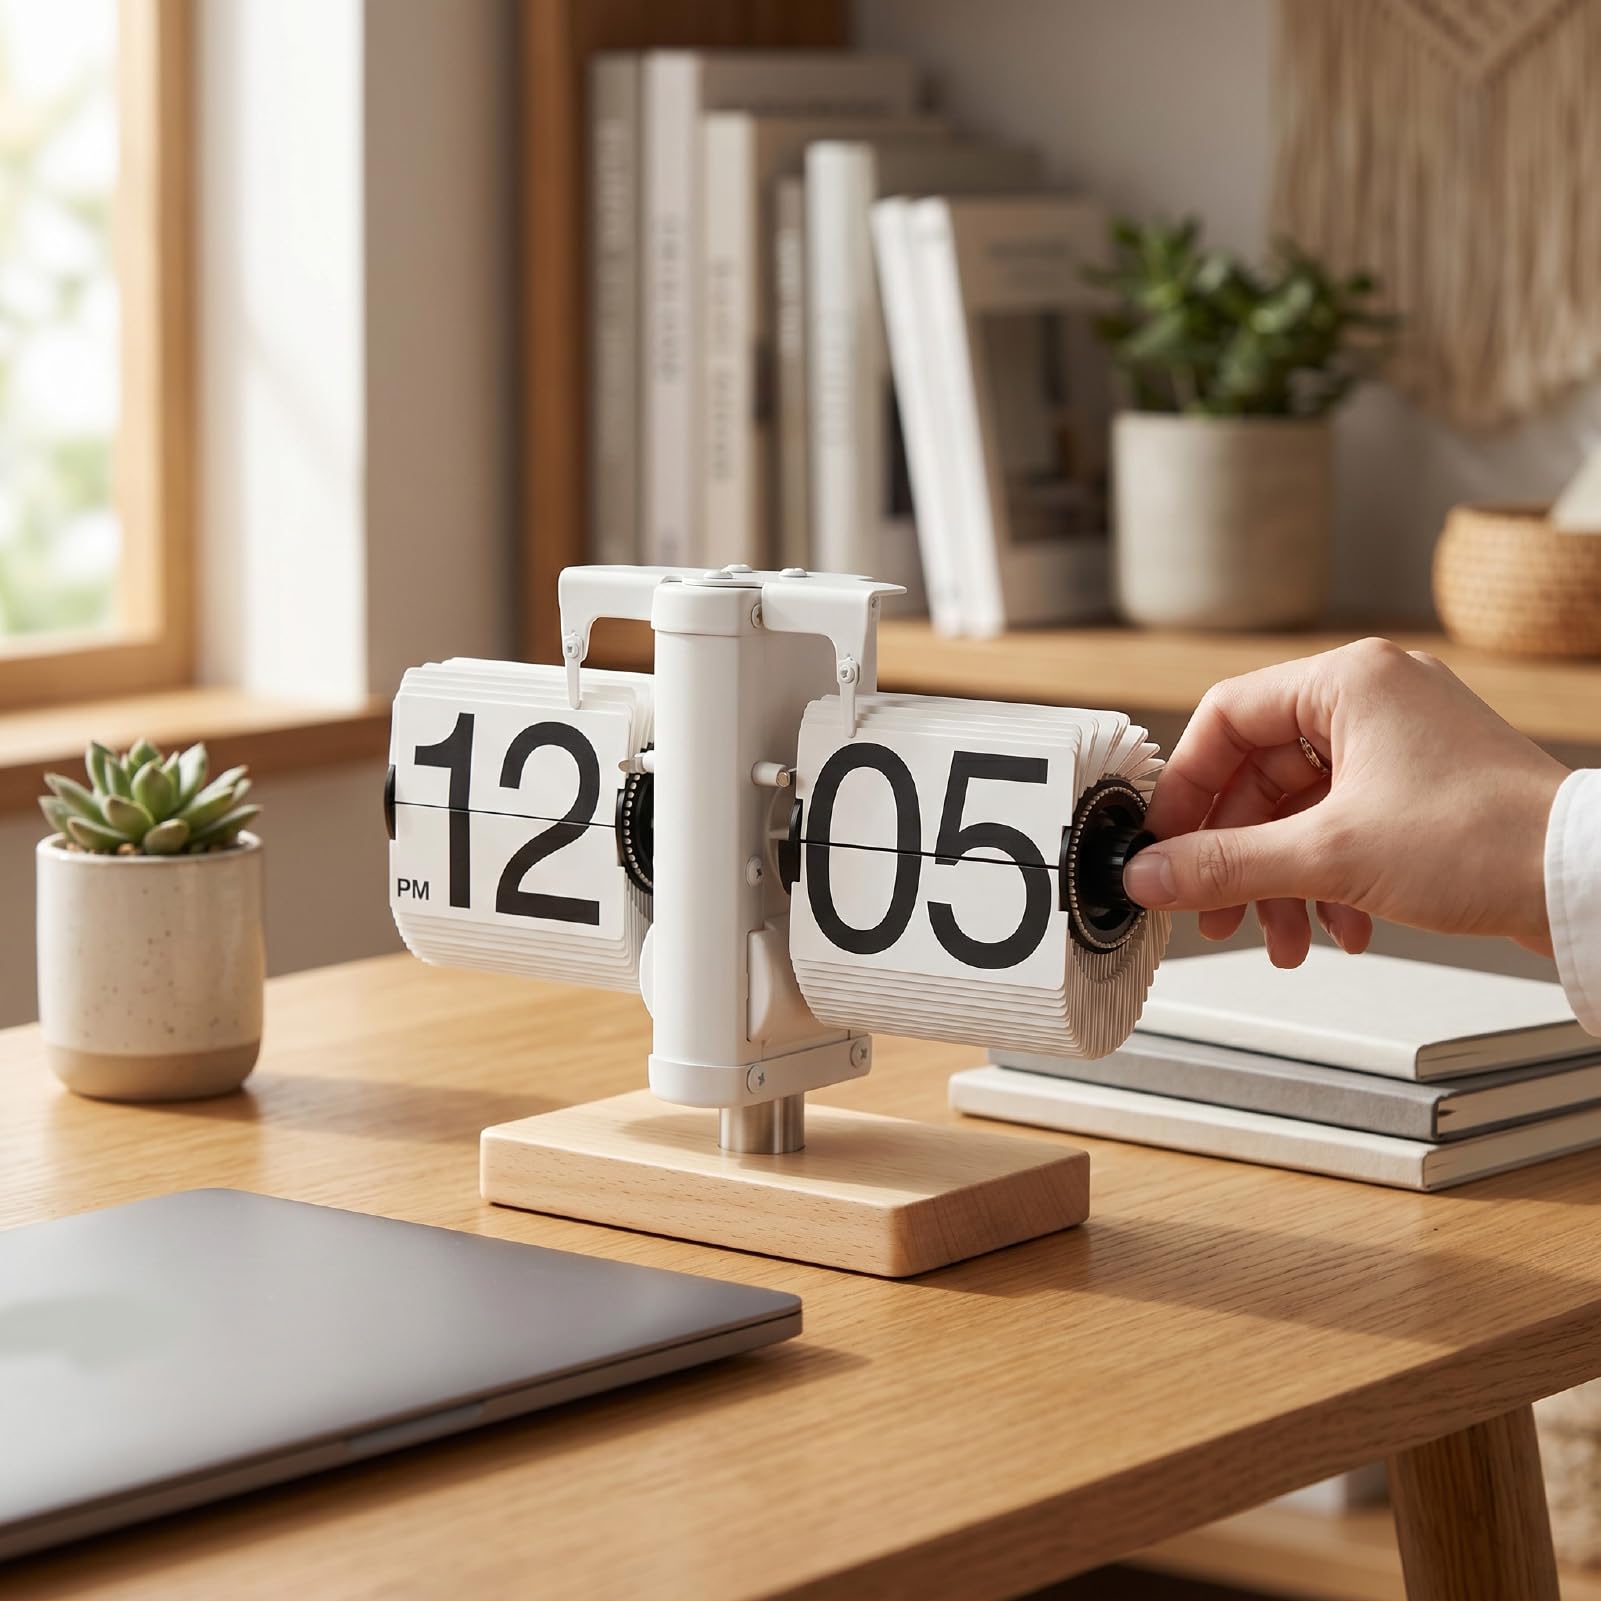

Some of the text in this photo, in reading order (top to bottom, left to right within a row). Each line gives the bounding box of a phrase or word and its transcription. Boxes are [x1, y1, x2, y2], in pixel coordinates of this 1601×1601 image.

[396, 878, 430, 902] PM
[414, 711, 600, 926] 12
[805, 742, 1052, 970] 05
